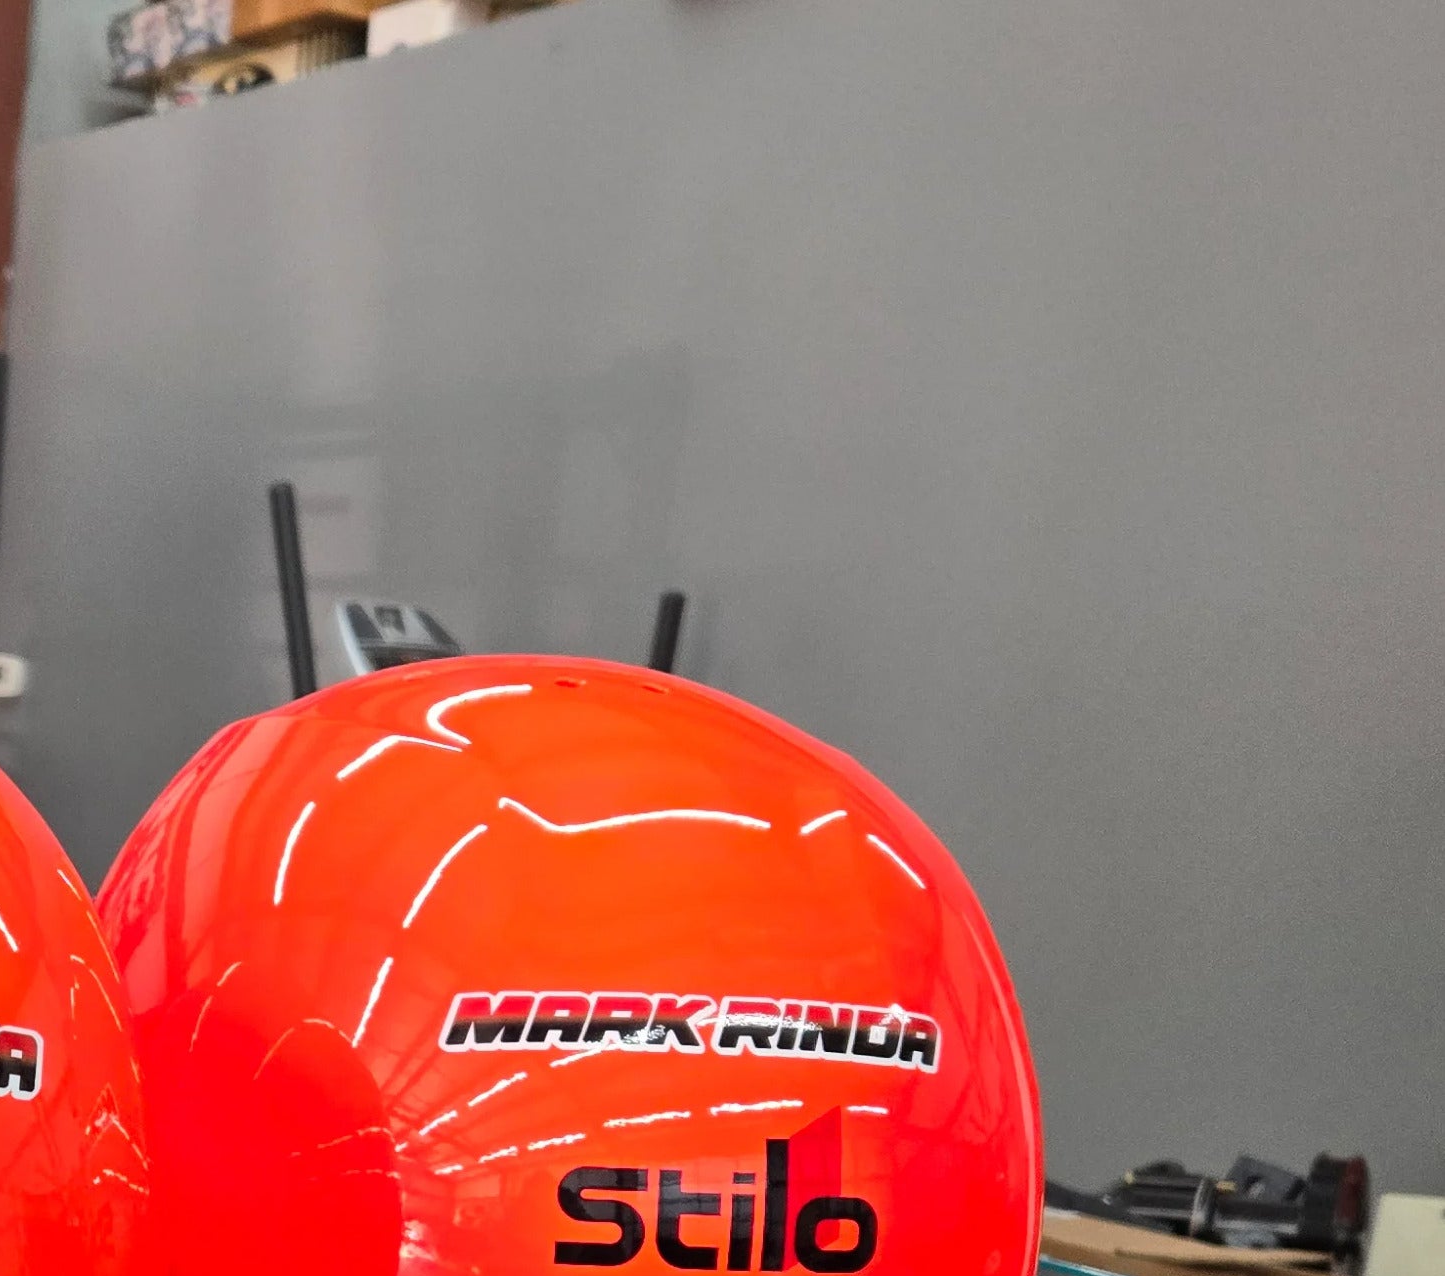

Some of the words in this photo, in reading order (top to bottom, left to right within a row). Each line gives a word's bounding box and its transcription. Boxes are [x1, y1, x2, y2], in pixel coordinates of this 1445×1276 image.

[443, 994, 714, 1048] MARK
[716, 999, 941, 1068] RINDA
[554, 1138, 879, 1274] Stilo
